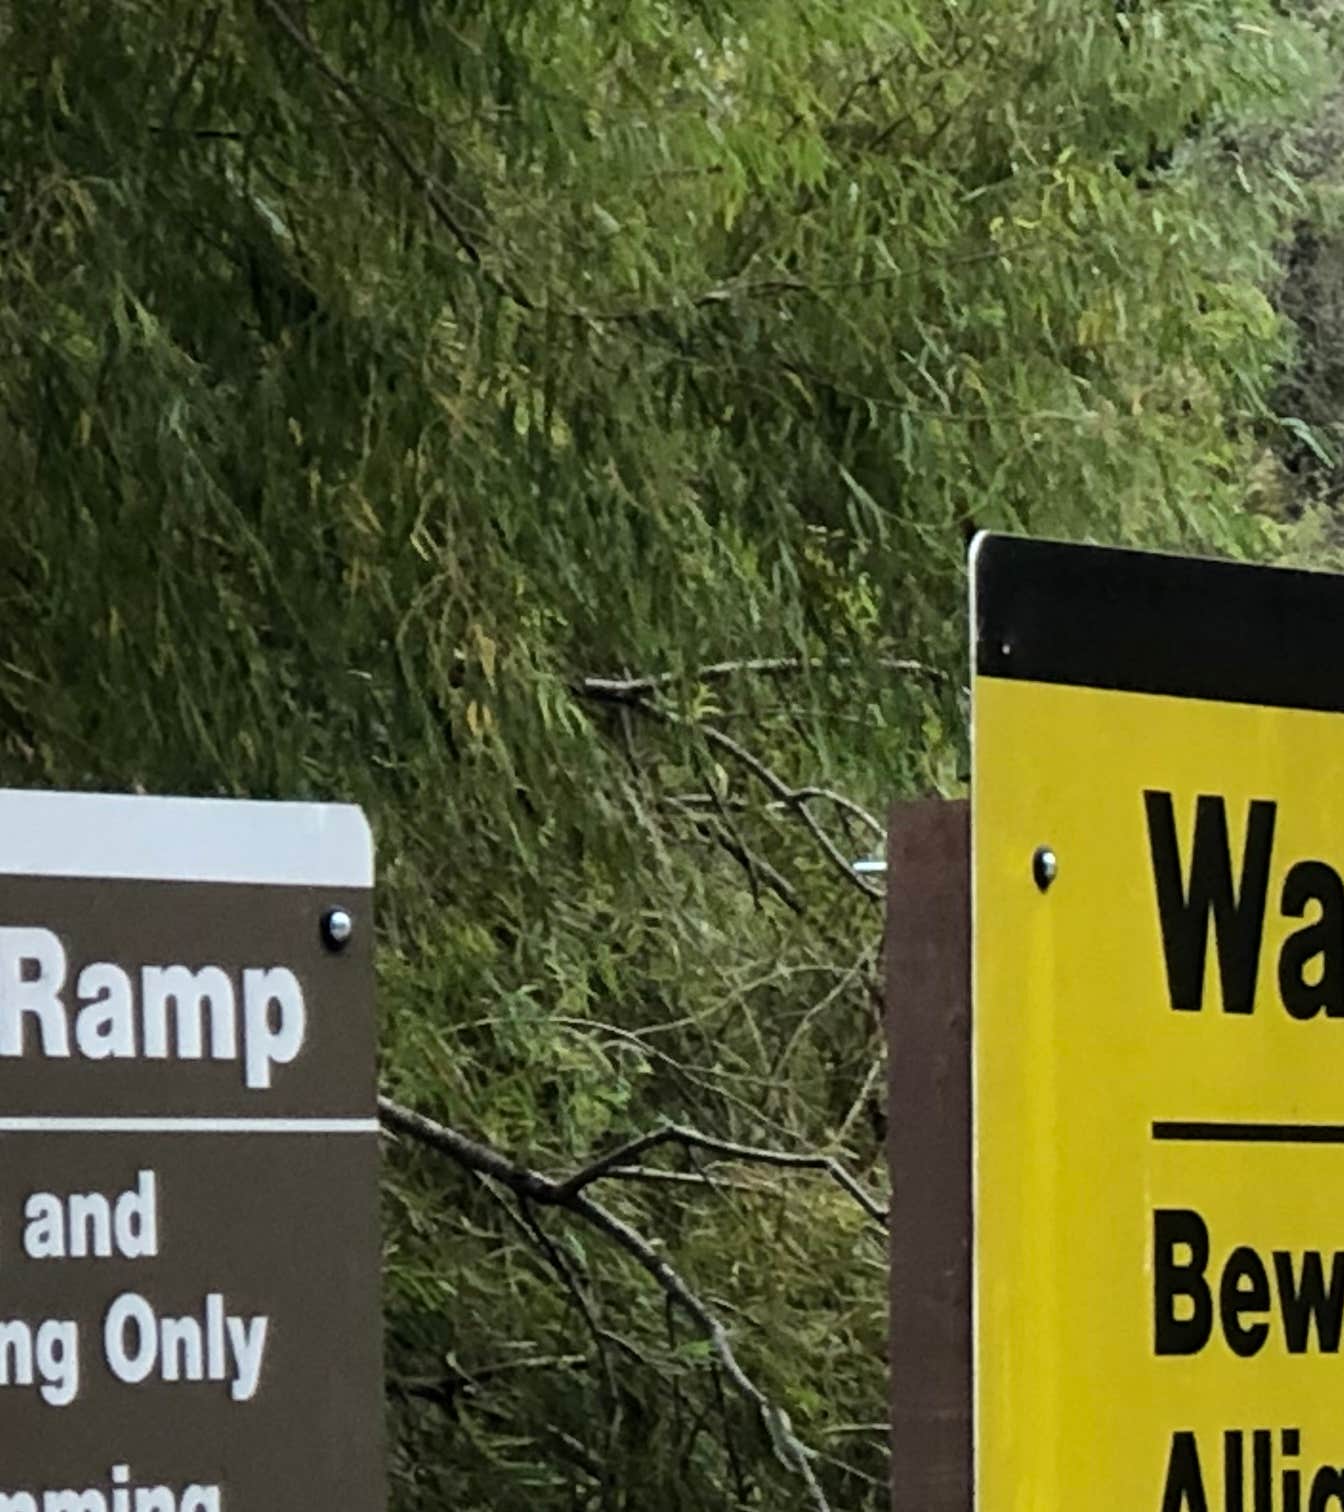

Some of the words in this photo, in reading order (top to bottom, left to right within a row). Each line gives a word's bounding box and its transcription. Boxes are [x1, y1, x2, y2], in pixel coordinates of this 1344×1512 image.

[0, 927, 306, 1088] Ramp
[25, 1170, 157, 1258] and
[106, 1294, 267, 1400] Only
